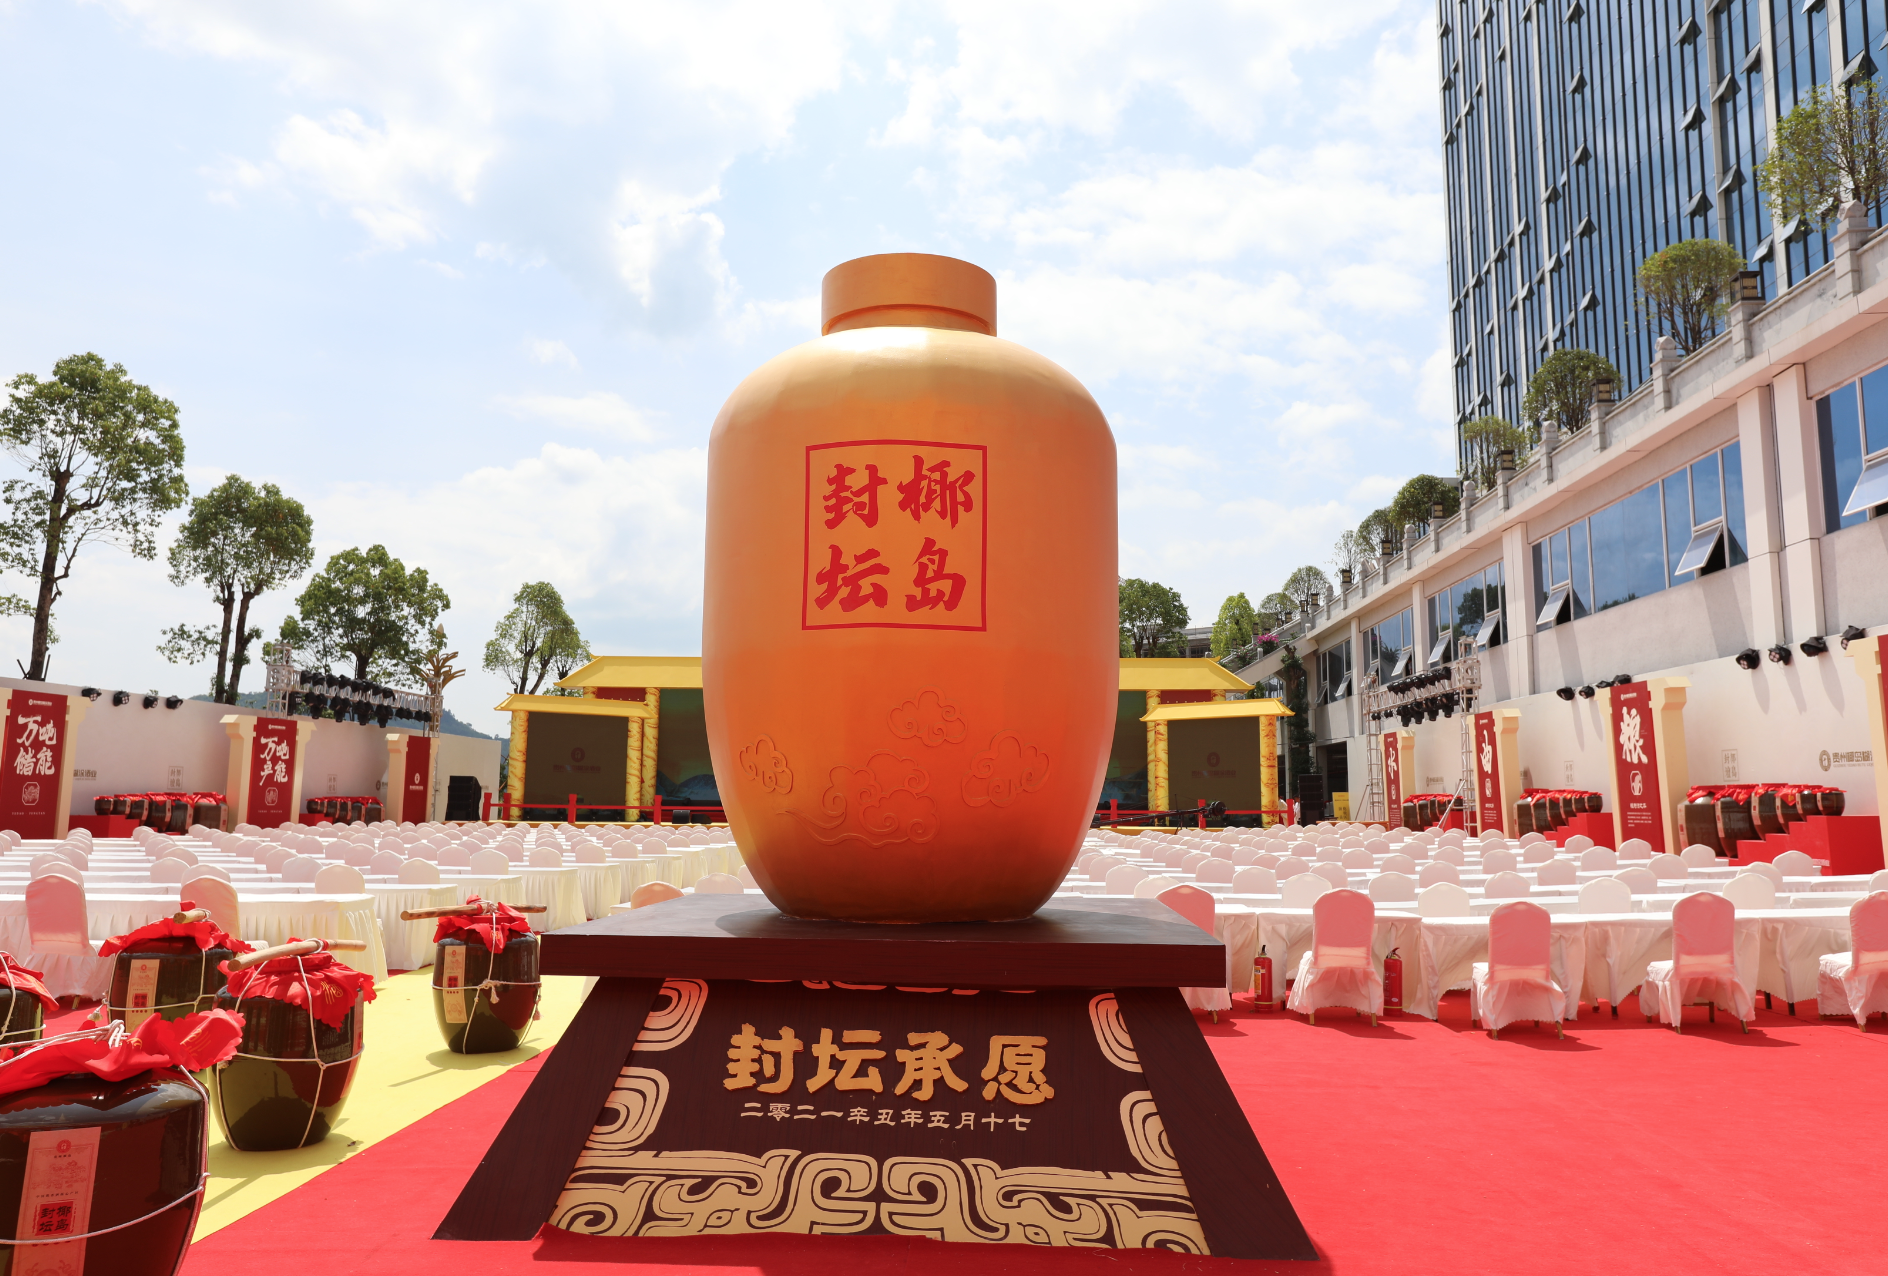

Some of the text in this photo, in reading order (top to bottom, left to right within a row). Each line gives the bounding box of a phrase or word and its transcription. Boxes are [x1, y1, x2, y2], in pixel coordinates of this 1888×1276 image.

[814, 463, 890, 613] 封坛
[897, 455, 976, 612] 椰岛
[16, 714, 57, 747] 万吨
[1619, 706, 1648, 764] 粮
[14, 746, 55, 776] 储能
[260, 736, 290, 760] 万吨
[1387, 747, 1397, 780] 水
[259, 760, 288, 786] 产能
[723, 1022, 1056, 1105] 封坛承愿
[740, 1102, 1031, 1132] 二零二一辛丑年五月十七
